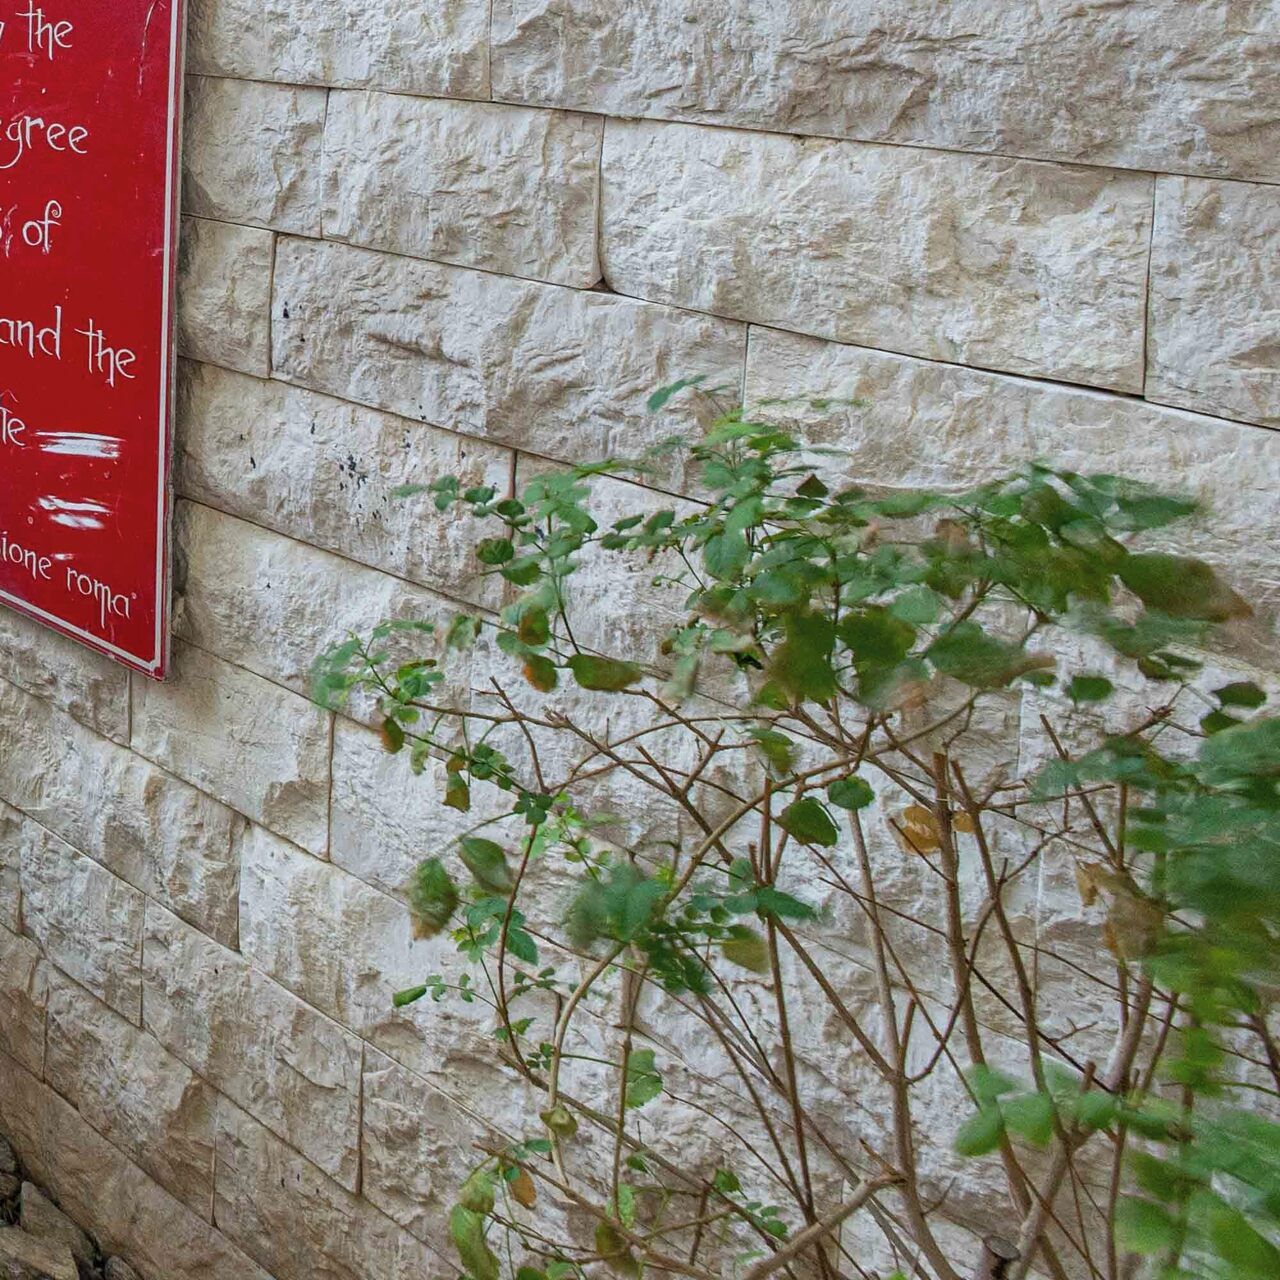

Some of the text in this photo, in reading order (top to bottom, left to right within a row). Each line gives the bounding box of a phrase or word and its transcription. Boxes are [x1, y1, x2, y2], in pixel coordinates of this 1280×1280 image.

[15, 0, 74, 62] the
[22, 200, 62, 254] of
[74, 318, 137, 388] the
